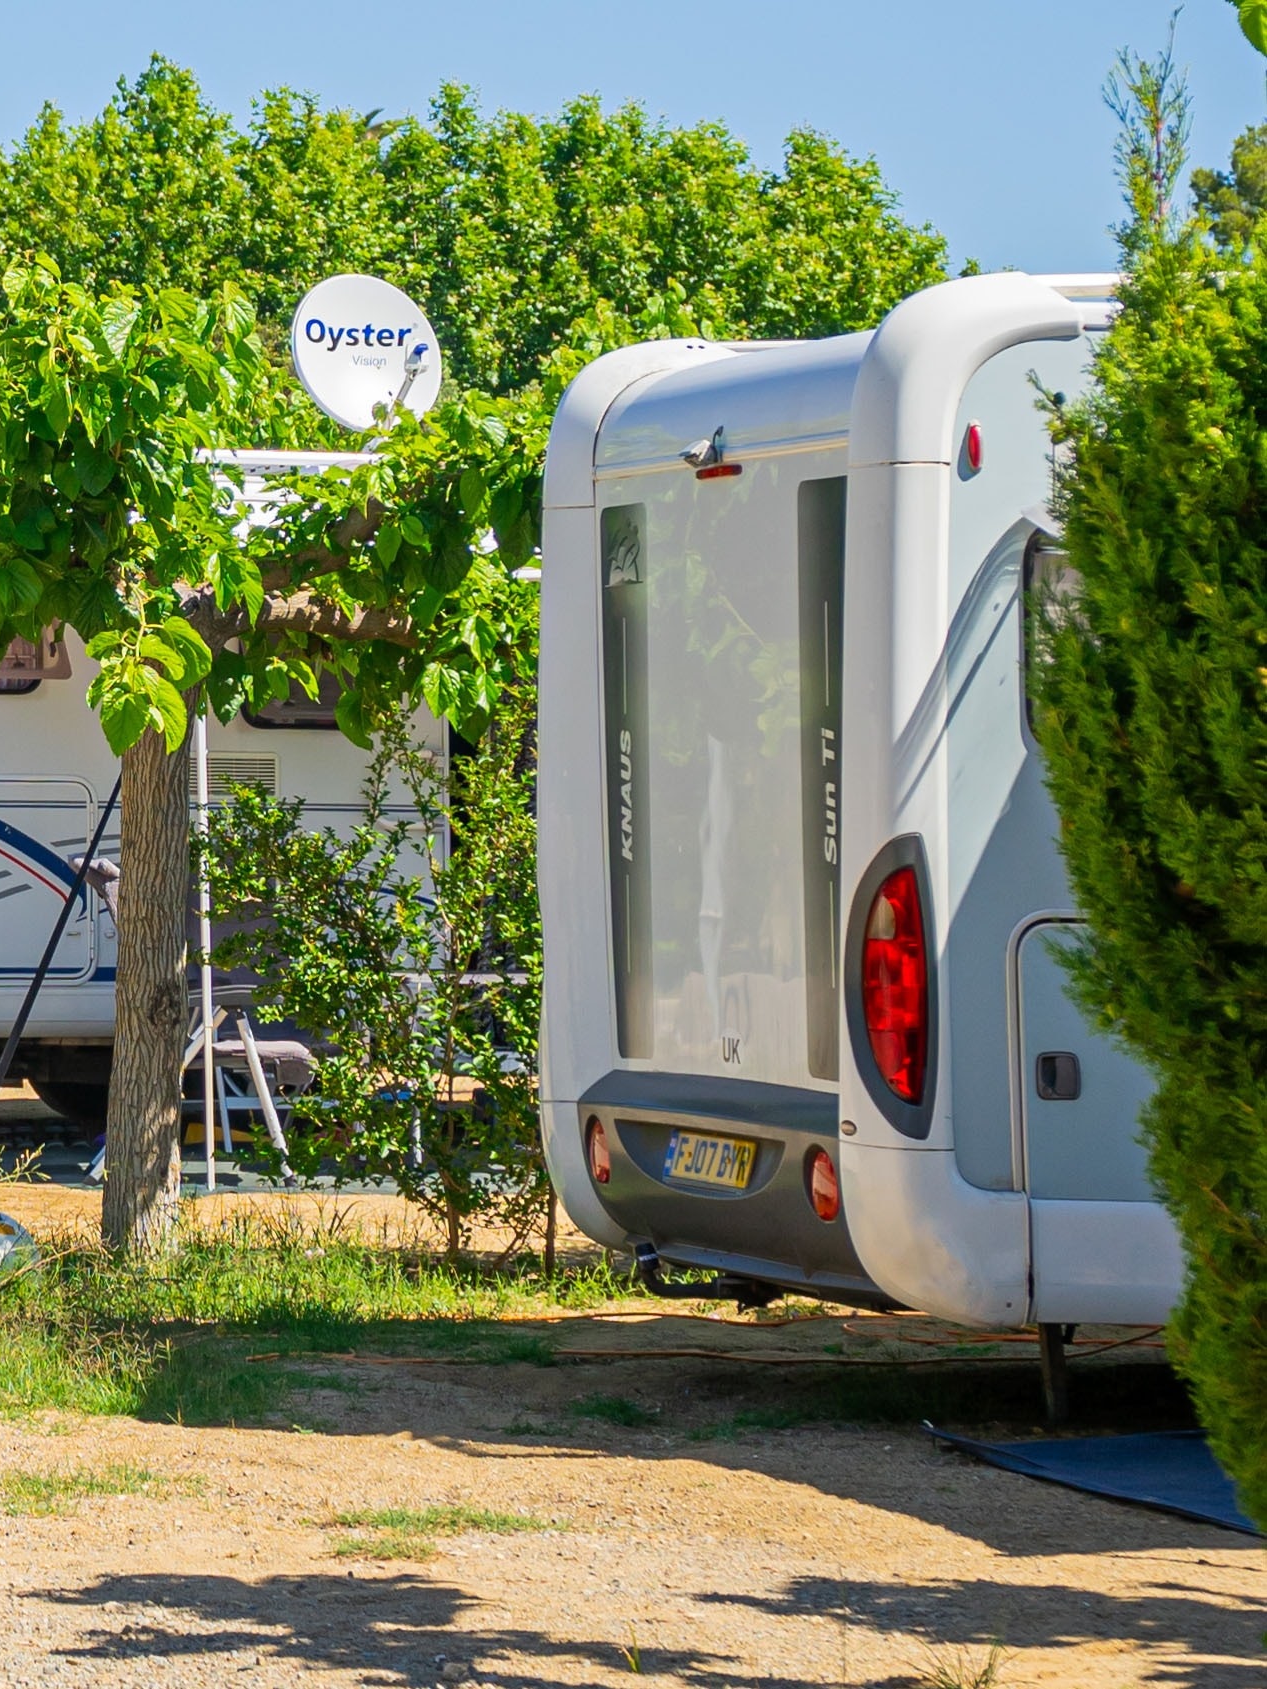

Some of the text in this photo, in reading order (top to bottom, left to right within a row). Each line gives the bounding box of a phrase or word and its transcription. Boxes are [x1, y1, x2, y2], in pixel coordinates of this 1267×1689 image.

[306, 319, 412, 352] Oyster
[352, 355, 387, 367] Vision
[620, 730, 634, 862] KNAUS
[825, 782, 838, 865] Sun
[722, 1036, 741, 1064] UK
[673, 1136, 751, 1182] FJ07 BYR
